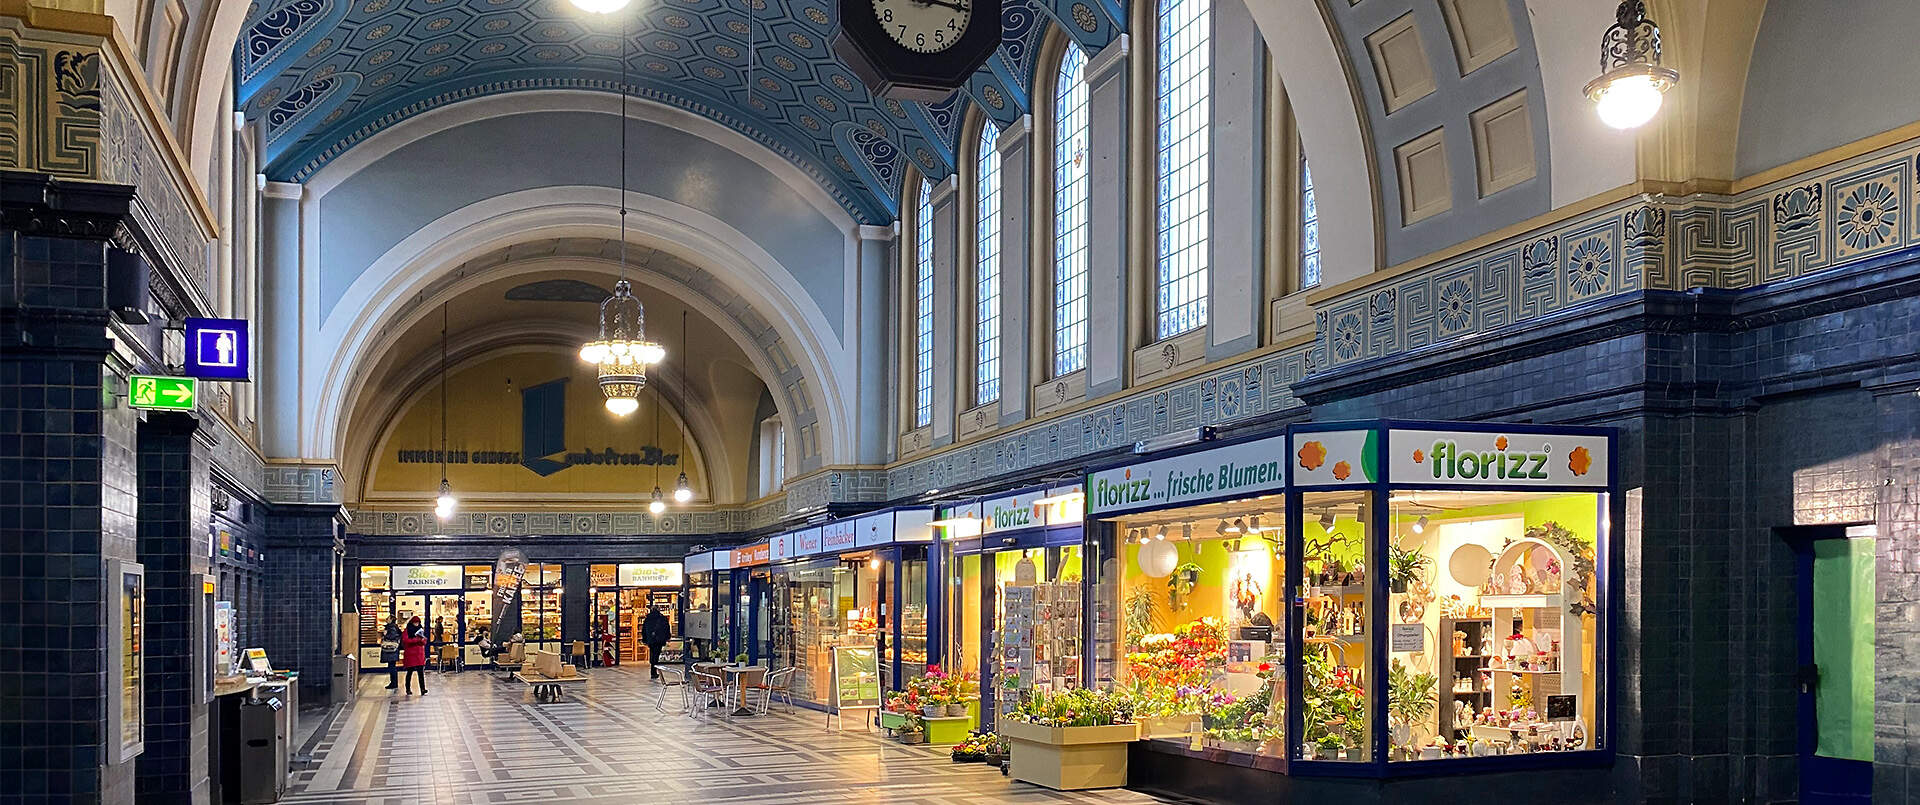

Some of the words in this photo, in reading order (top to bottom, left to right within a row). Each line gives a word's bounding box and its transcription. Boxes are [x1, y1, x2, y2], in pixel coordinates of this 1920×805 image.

[884, 9, 893, 22] 8
[898, 25, 907, 38] 7
[947, 18, 956, 31] 4
[916, 33, 925, 46] 6
[935, 30, 944, 43] 5
[398, 450, 443, 464] IMMER
[447, 449, 468, 464] EIN
[1431, 436, 1548, 479] florizz
[1218, 461, 1282, 490] Blumen.
[994, 498, 1030, 529] florizz
[799, 534, 817, 550] Wiener
[407, 568, 431, 579] Bio
[502, 566, 525, 604] KAFFEE
